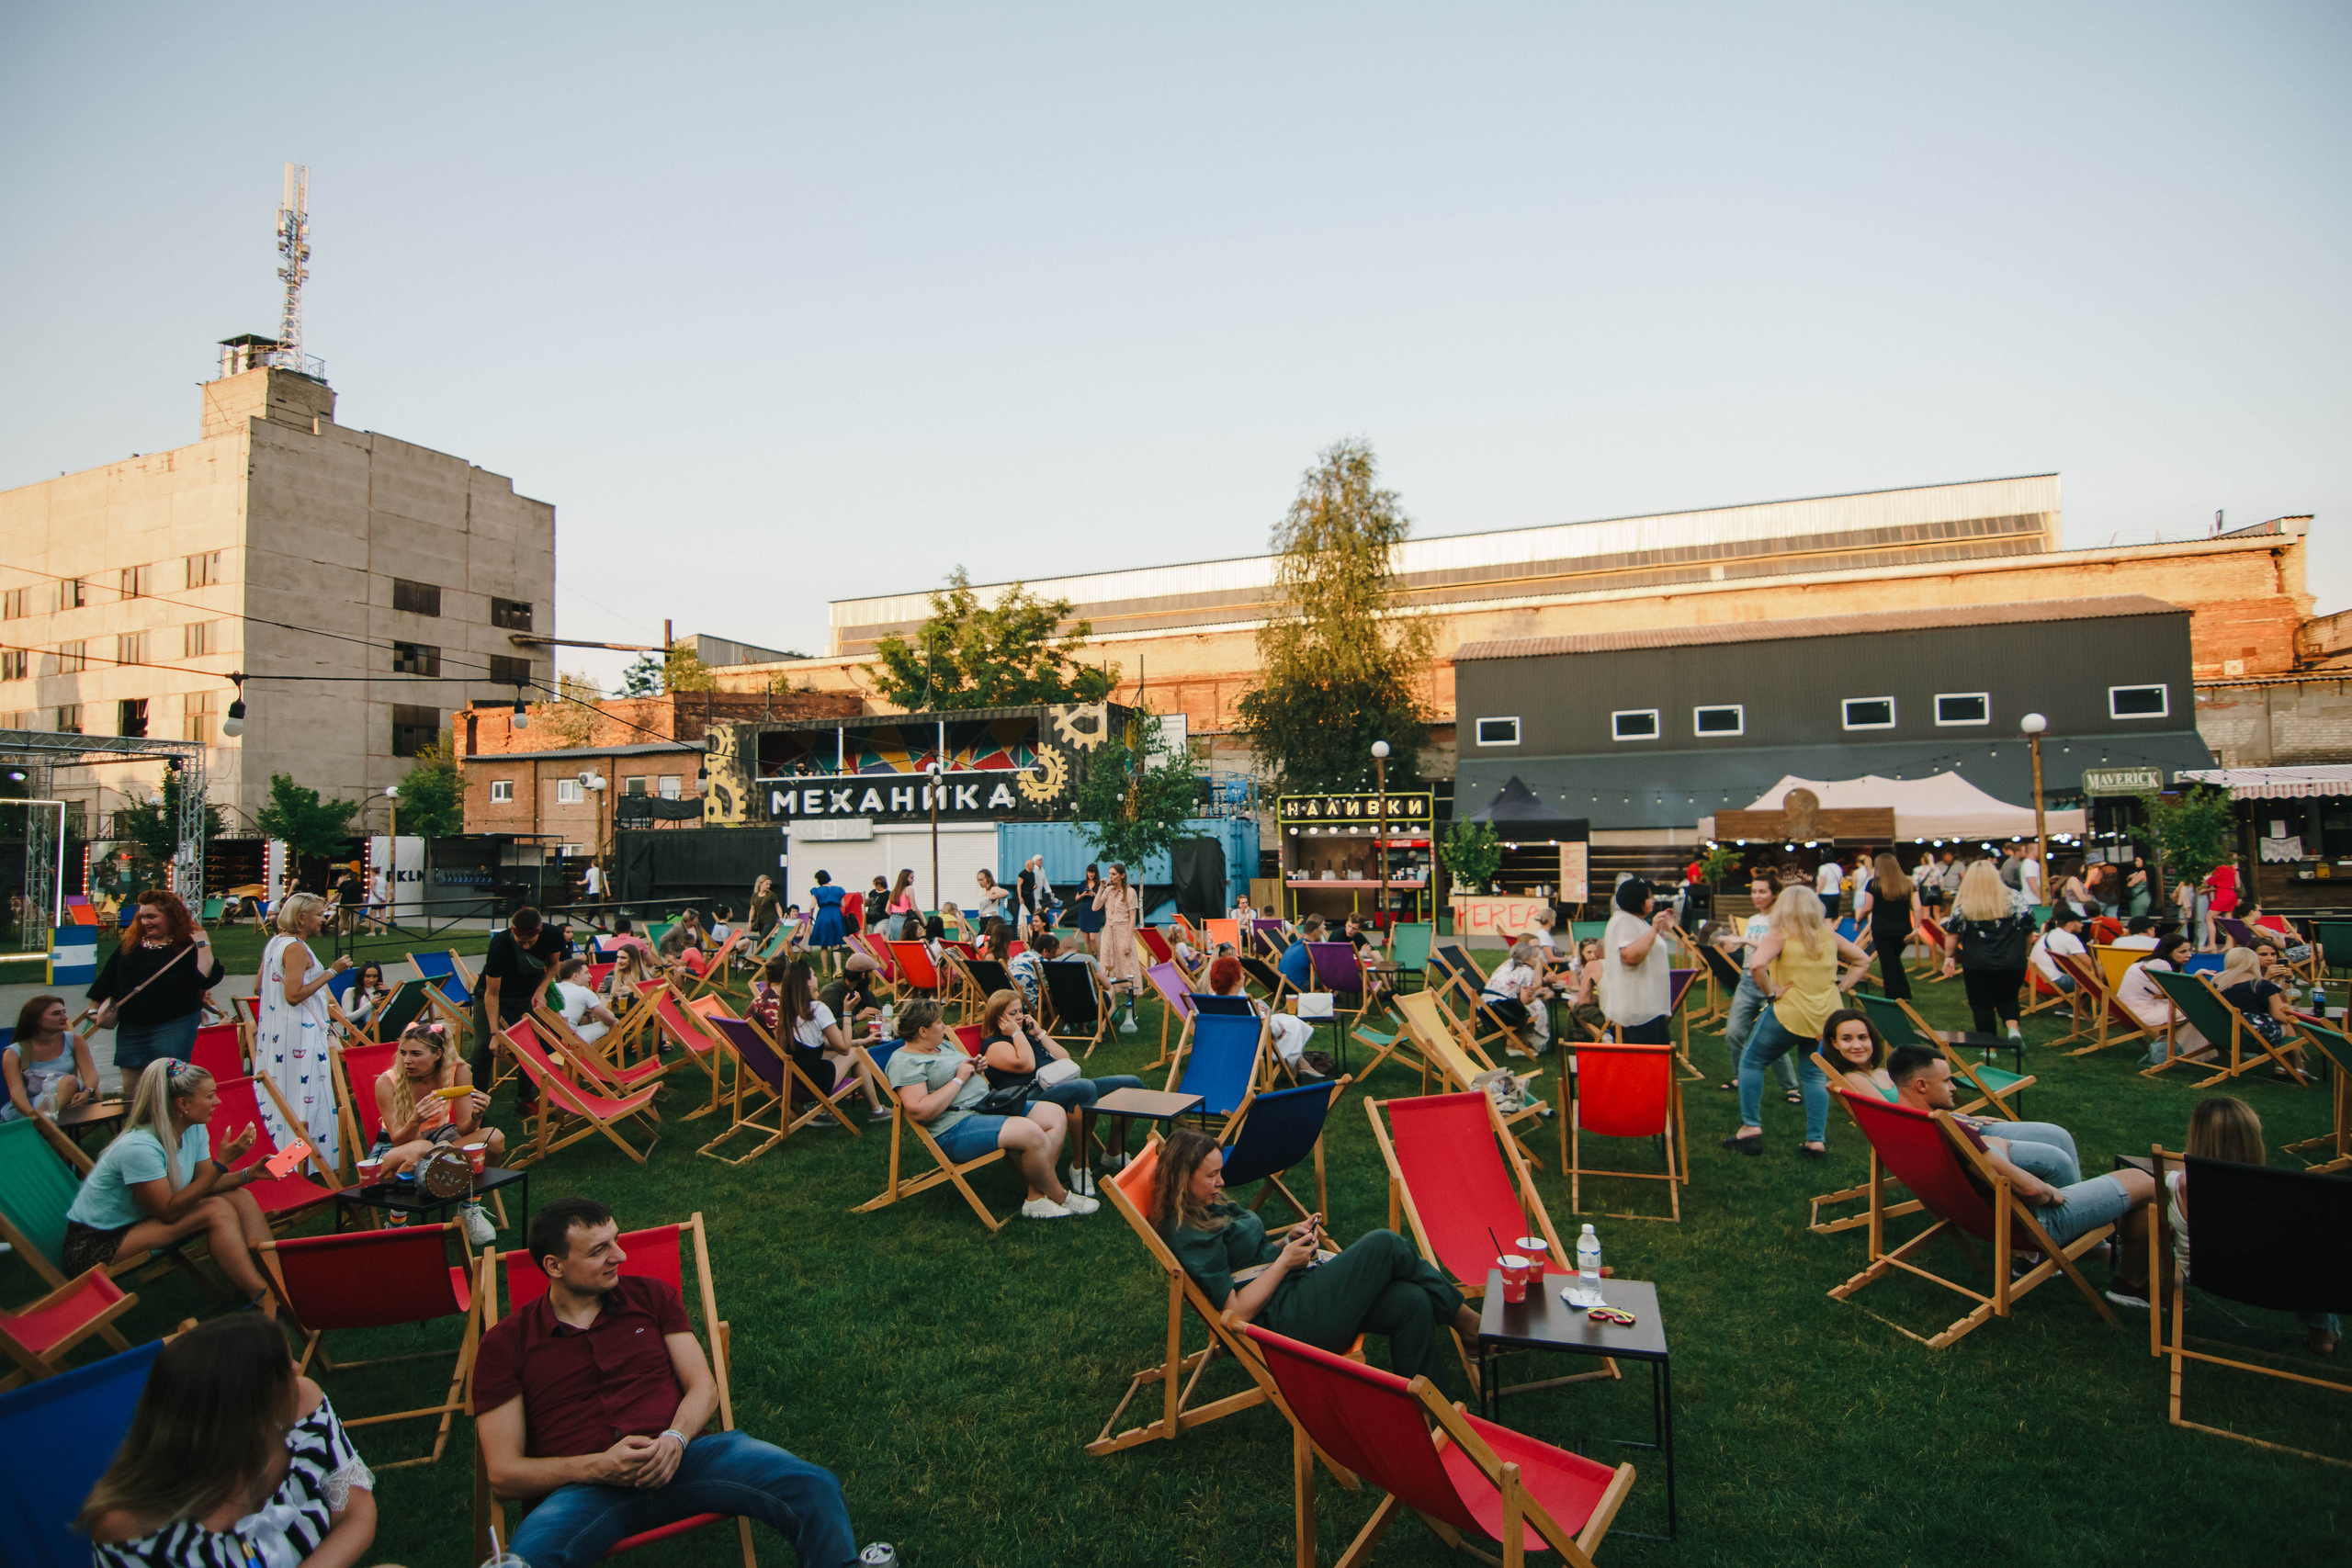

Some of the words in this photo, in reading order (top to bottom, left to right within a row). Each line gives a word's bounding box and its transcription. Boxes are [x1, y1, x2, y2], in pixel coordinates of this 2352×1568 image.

[2086, 772, 2159, 790] MAVERICK
[772, 783, 1016, 815] МЕХАНИКА
[1287, 799, 1422, 816] НАЛИВКИ
